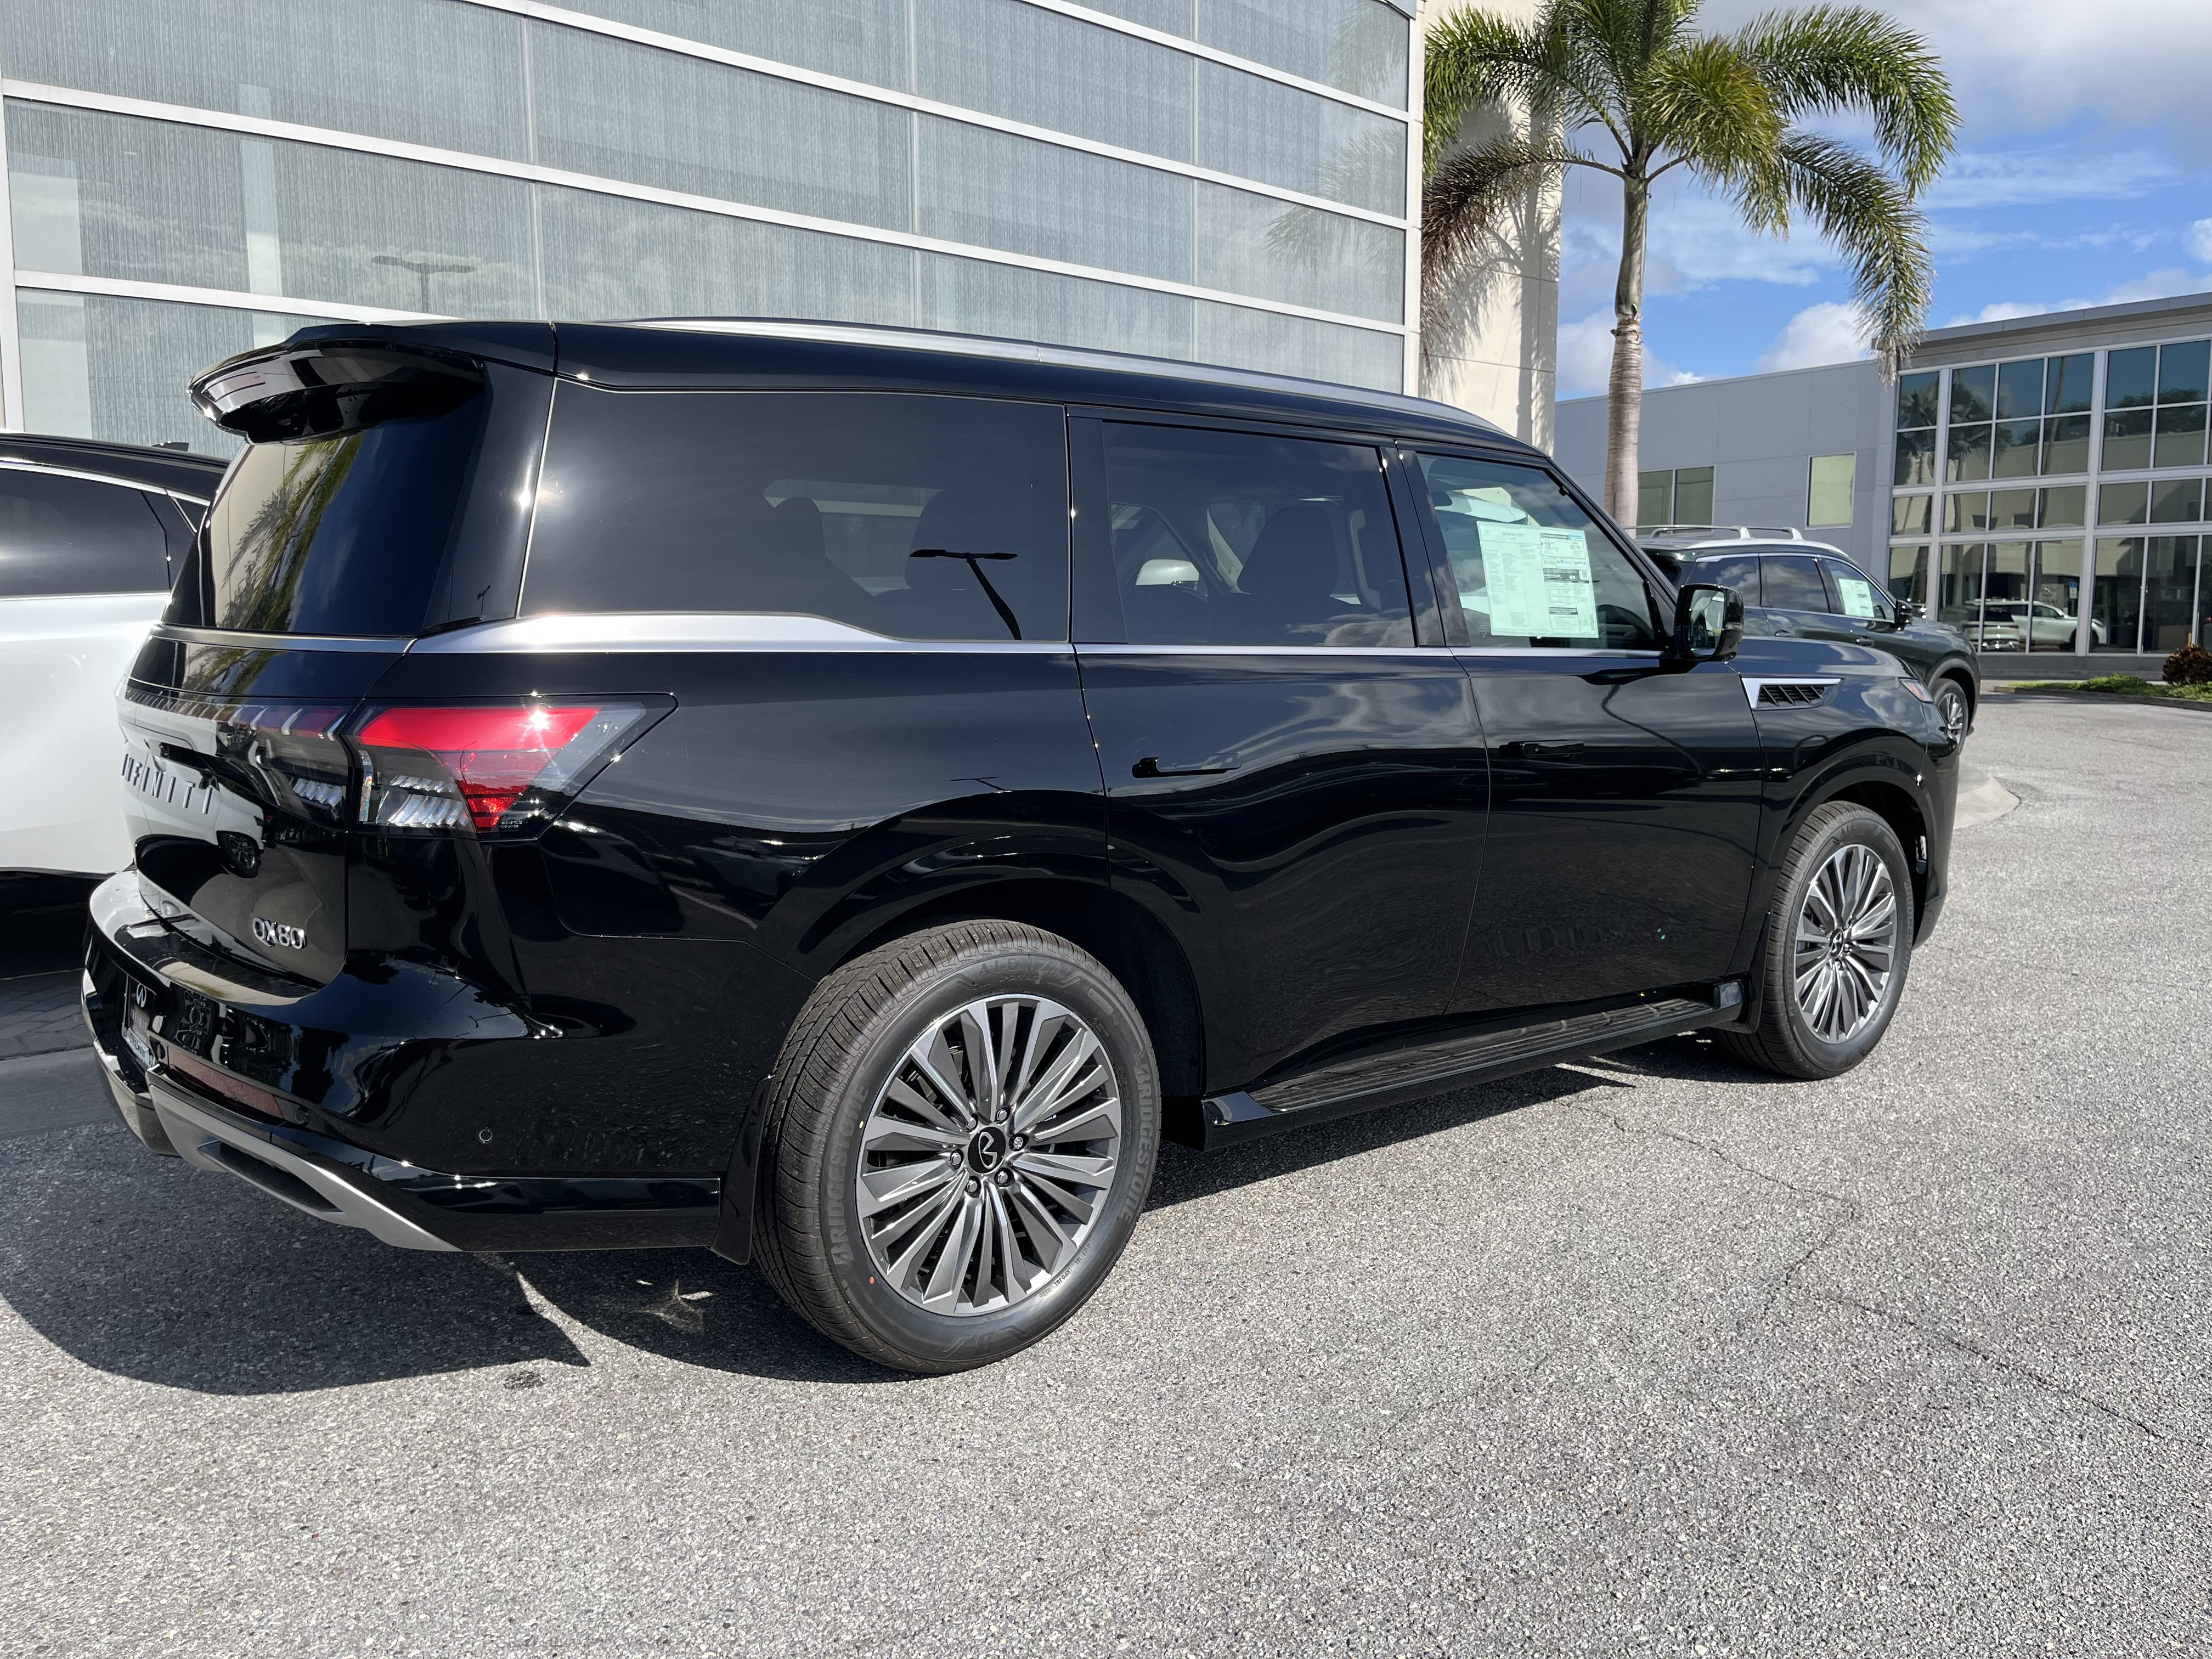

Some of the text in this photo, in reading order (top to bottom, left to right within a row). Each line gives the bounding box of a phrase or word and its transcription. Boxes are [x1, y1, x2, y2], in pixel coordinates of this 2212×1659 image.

[122, 754, 213, 814] INFINITI
[253, 917, 307, 950] QX80
[827, 1086, 869, 1265] BRIDGESTONE
[1120, 1063, 1154, 1224] BRIDGESTONE
